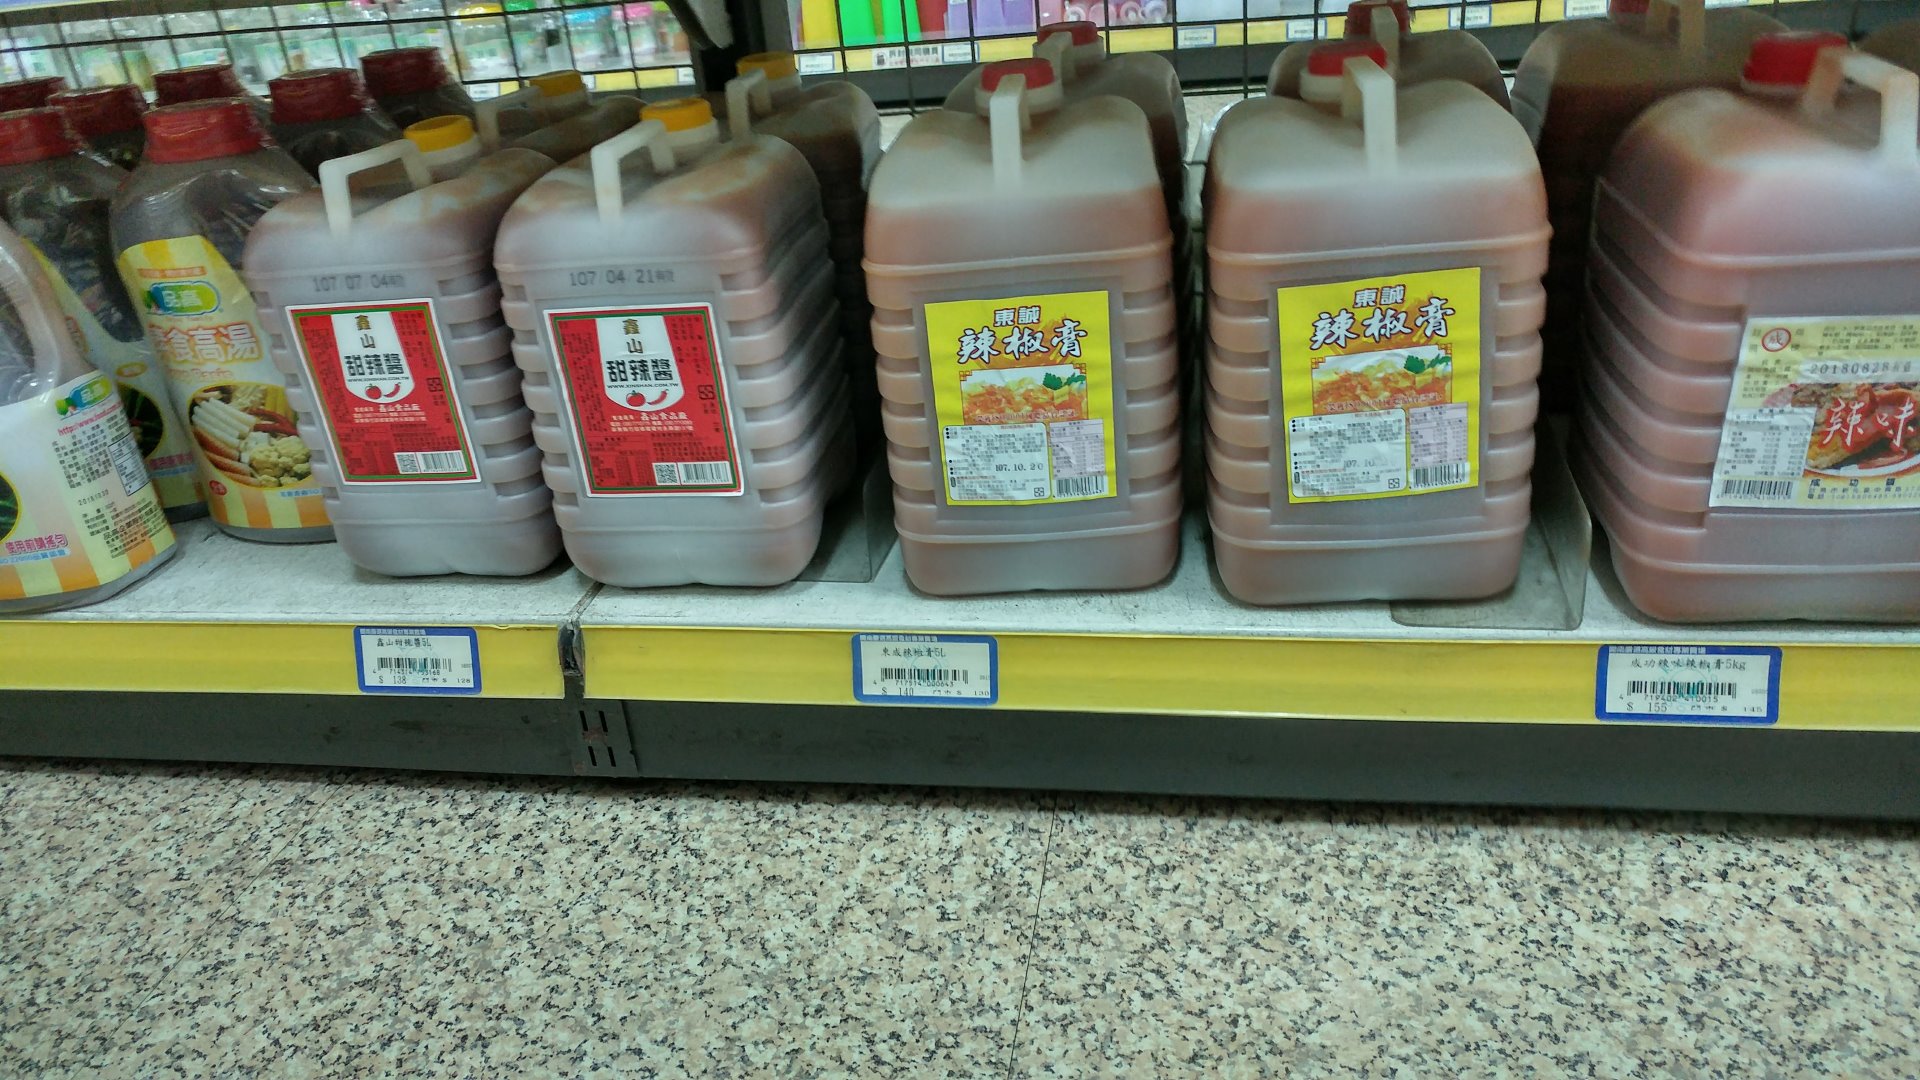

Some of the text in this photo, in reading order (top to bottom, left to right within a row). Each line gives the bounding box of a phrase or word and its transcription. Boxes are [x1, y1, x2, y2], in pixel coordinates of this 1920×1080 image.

[1351, 284, 1406, 309] 東誠
[993, 304, 1042, 328] 東誠
[1309, 296, 1456, 351] 辣椒膏
[956, 318, 1088, 365] 辣椒膏
[606, 358, 674, 382] 甜辣醬
[1822, 397, 1915, 448] 辣味
[393, 675, 407, 684] 138
[899, 687, 915, 696] 140
[1648, 702, 1668, 712] 155
